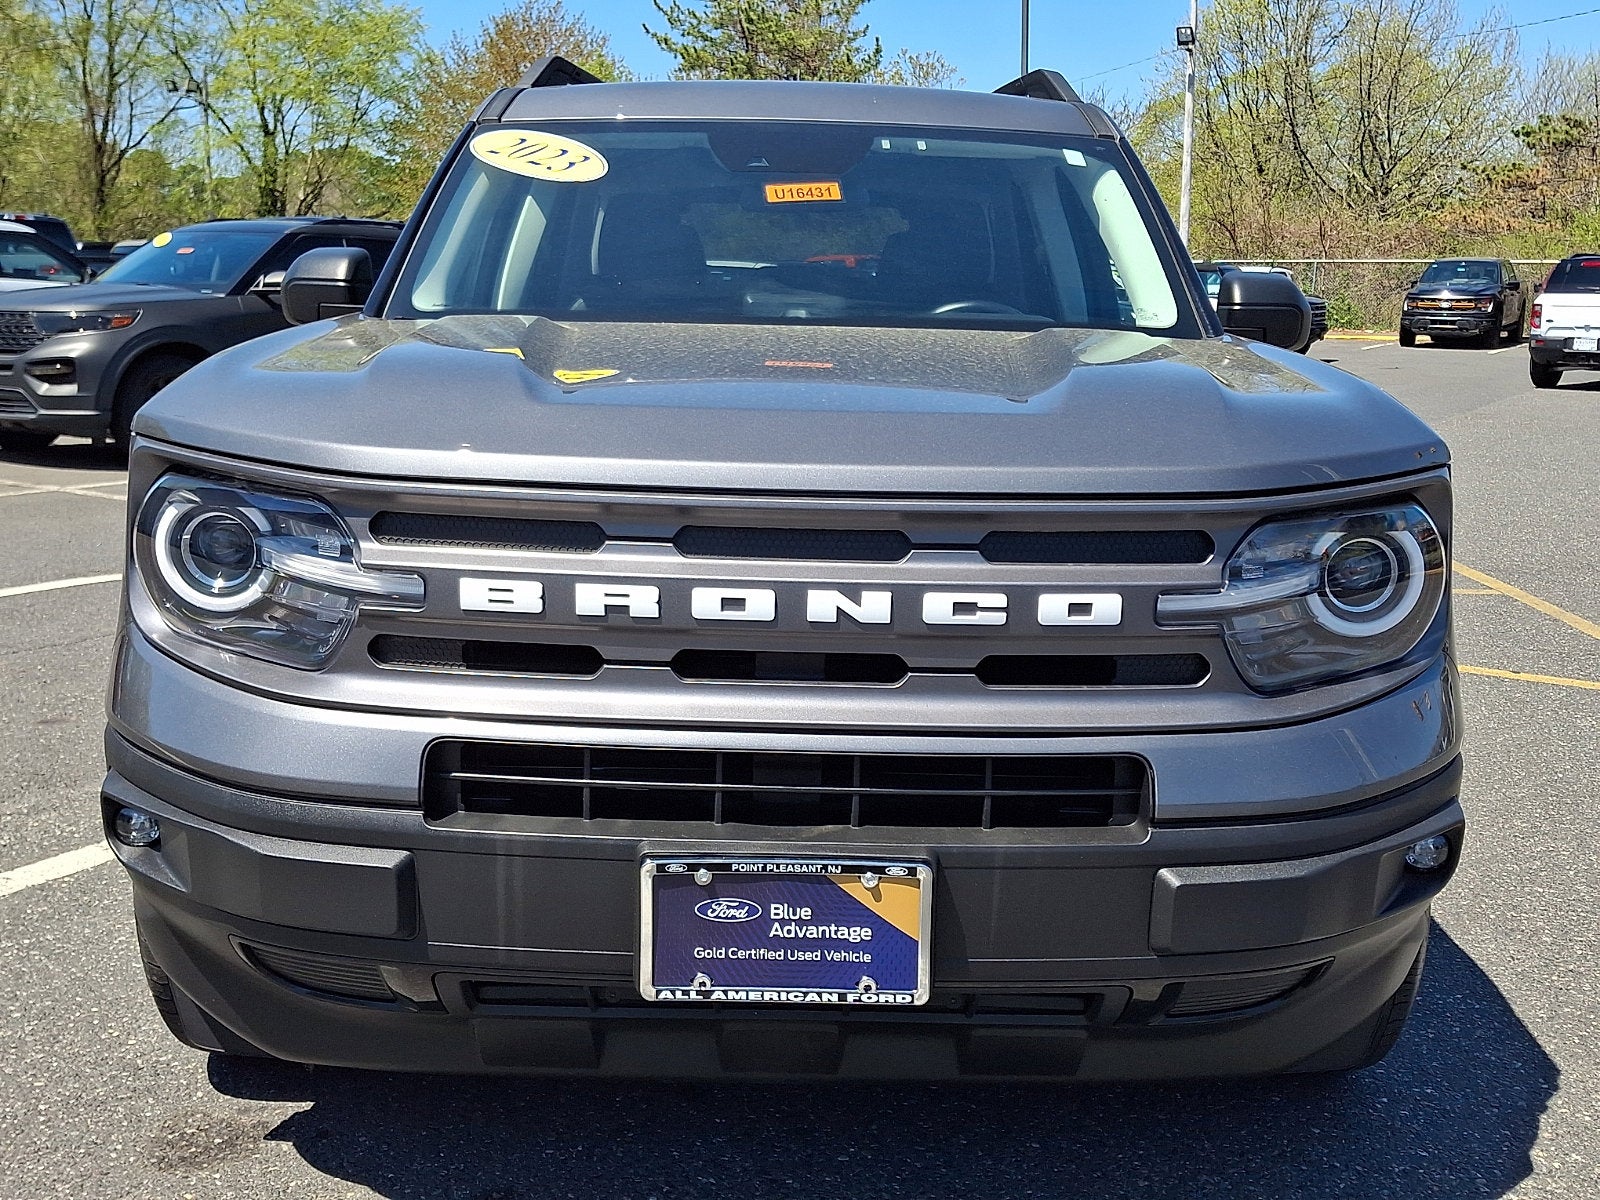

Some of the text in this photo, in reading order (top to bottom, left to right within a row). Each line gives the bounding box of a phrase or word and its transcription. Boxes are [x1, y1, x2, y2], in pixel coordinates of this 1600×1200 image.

[486, 138, 590, 172] 2023
[774, 187, 832, 199] U16431
[459, 577, 1122, 626] BRONCO
[731, 863, 842, 874] POINT PLEASANT, NJ
[707, 901, 750, 918] Ford
[770, 903, 812, 920] Blue
[769, 921, 872, 943] Advantage
[693, 946, 872, 963] Gold Certified Used Vehicle
[657, 990, 913, 1003] ALL AMERICAN FORD
